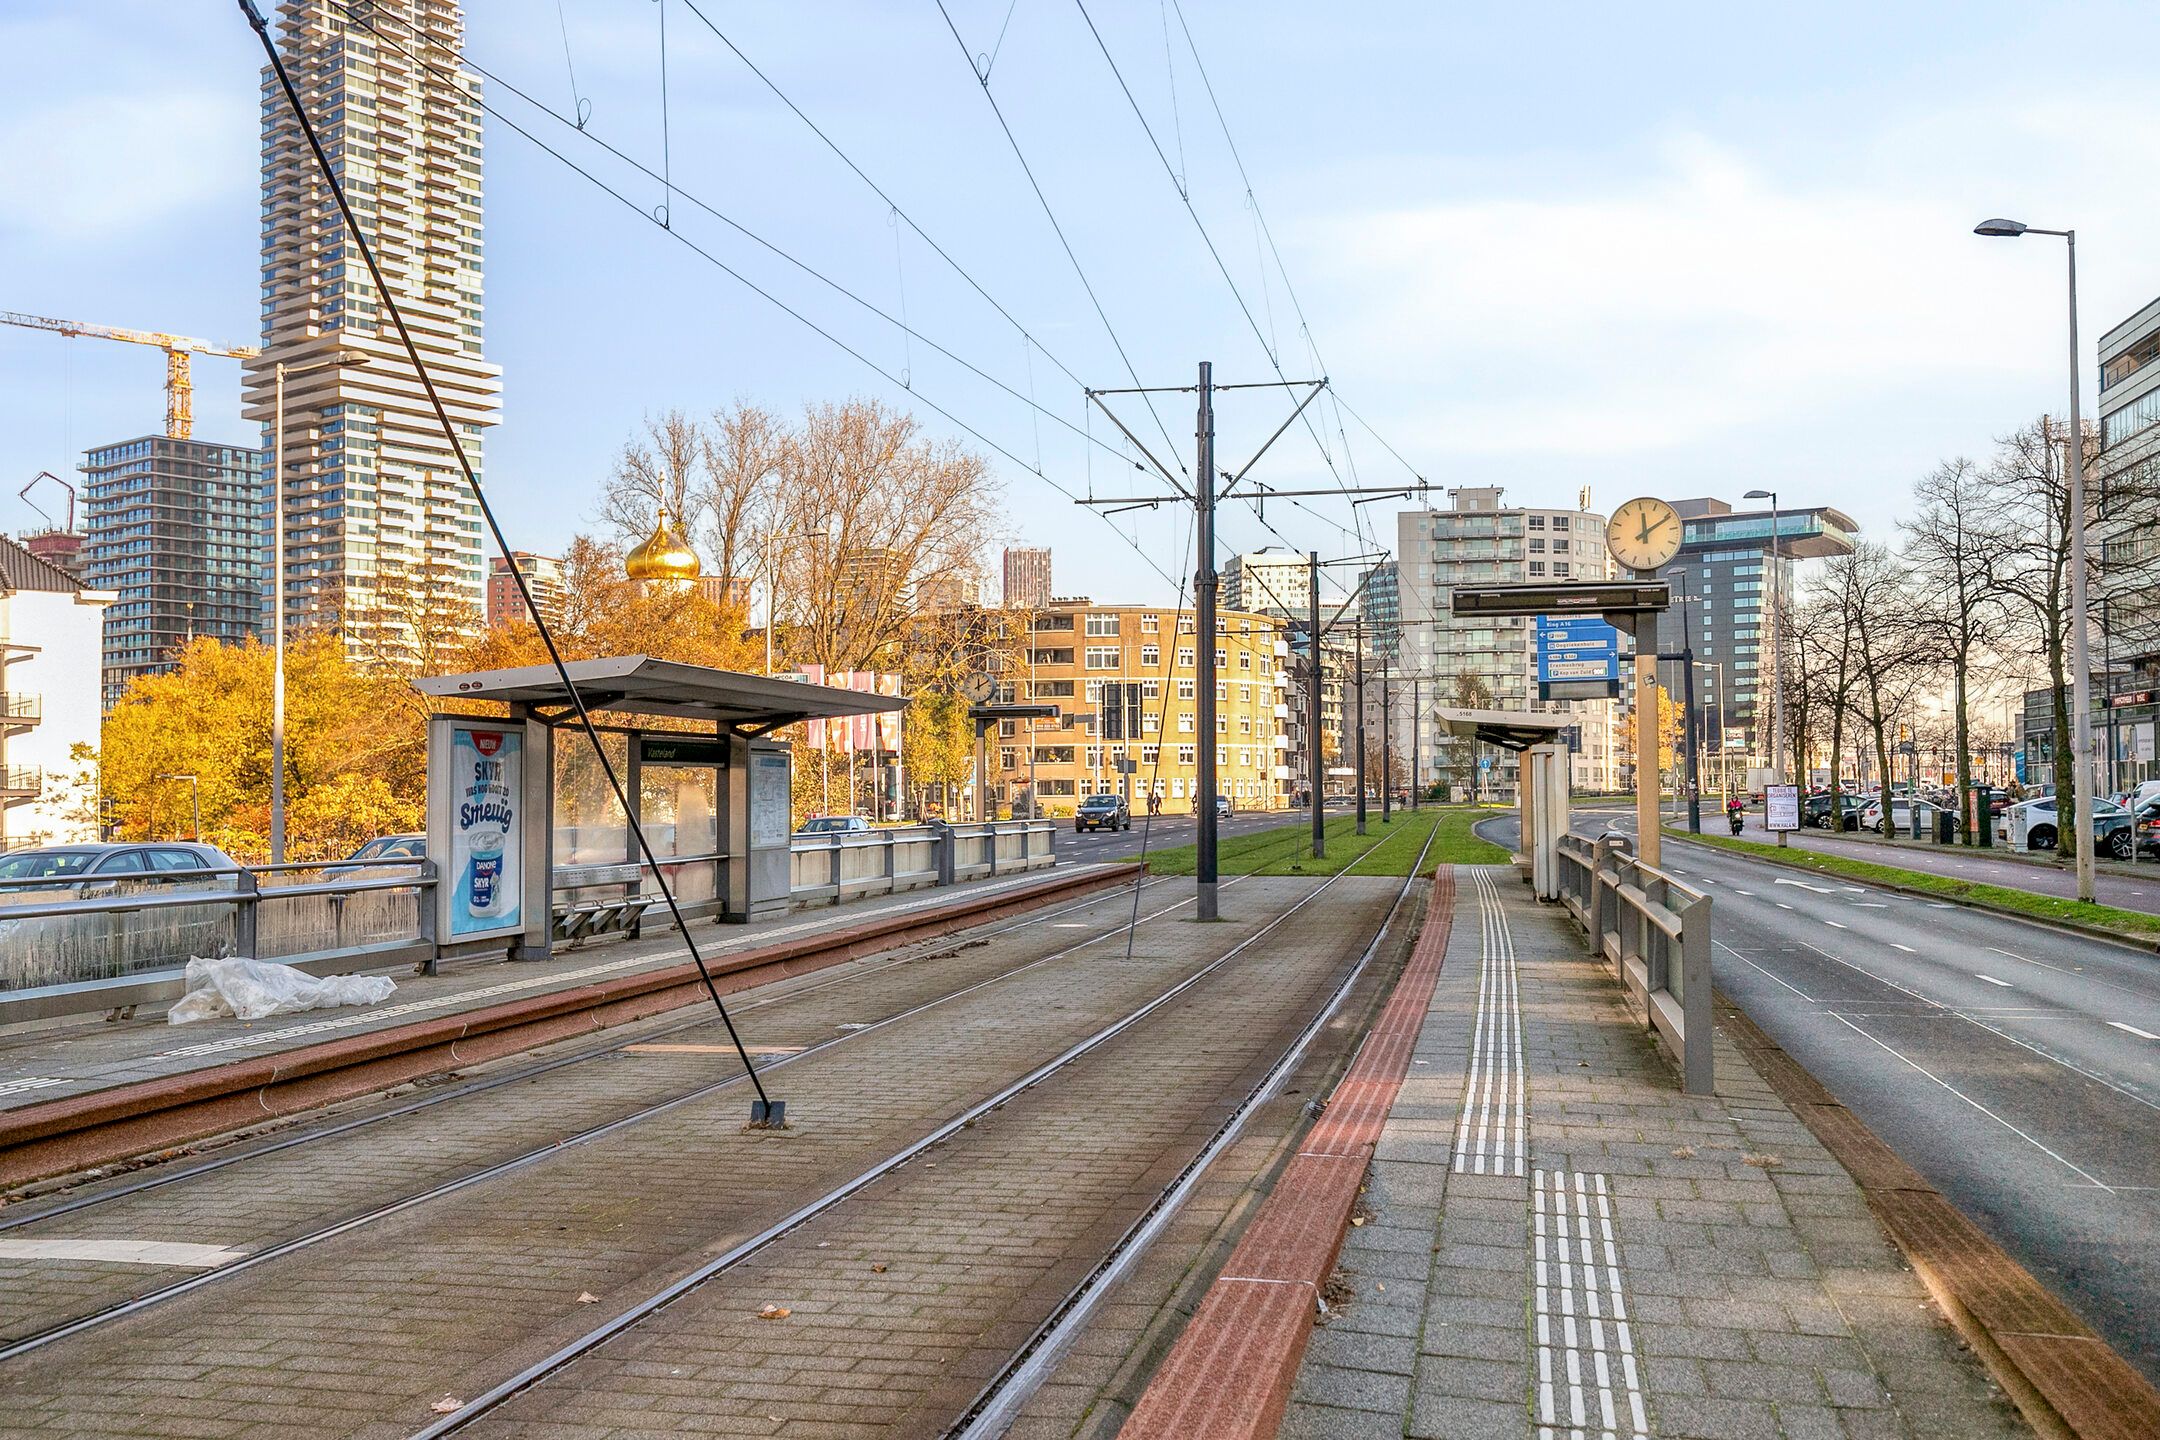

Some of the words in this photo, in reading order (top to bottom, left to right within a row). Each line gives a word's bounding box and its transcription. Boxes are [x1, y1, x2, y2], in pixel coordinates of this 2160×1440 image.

[647, 748, 676, 758] Vasteland
[474, 760, 503, 781] SKYR
[460, 799, 513, 833] Smeuïg
[474, 877, 489, 888] SKYR
